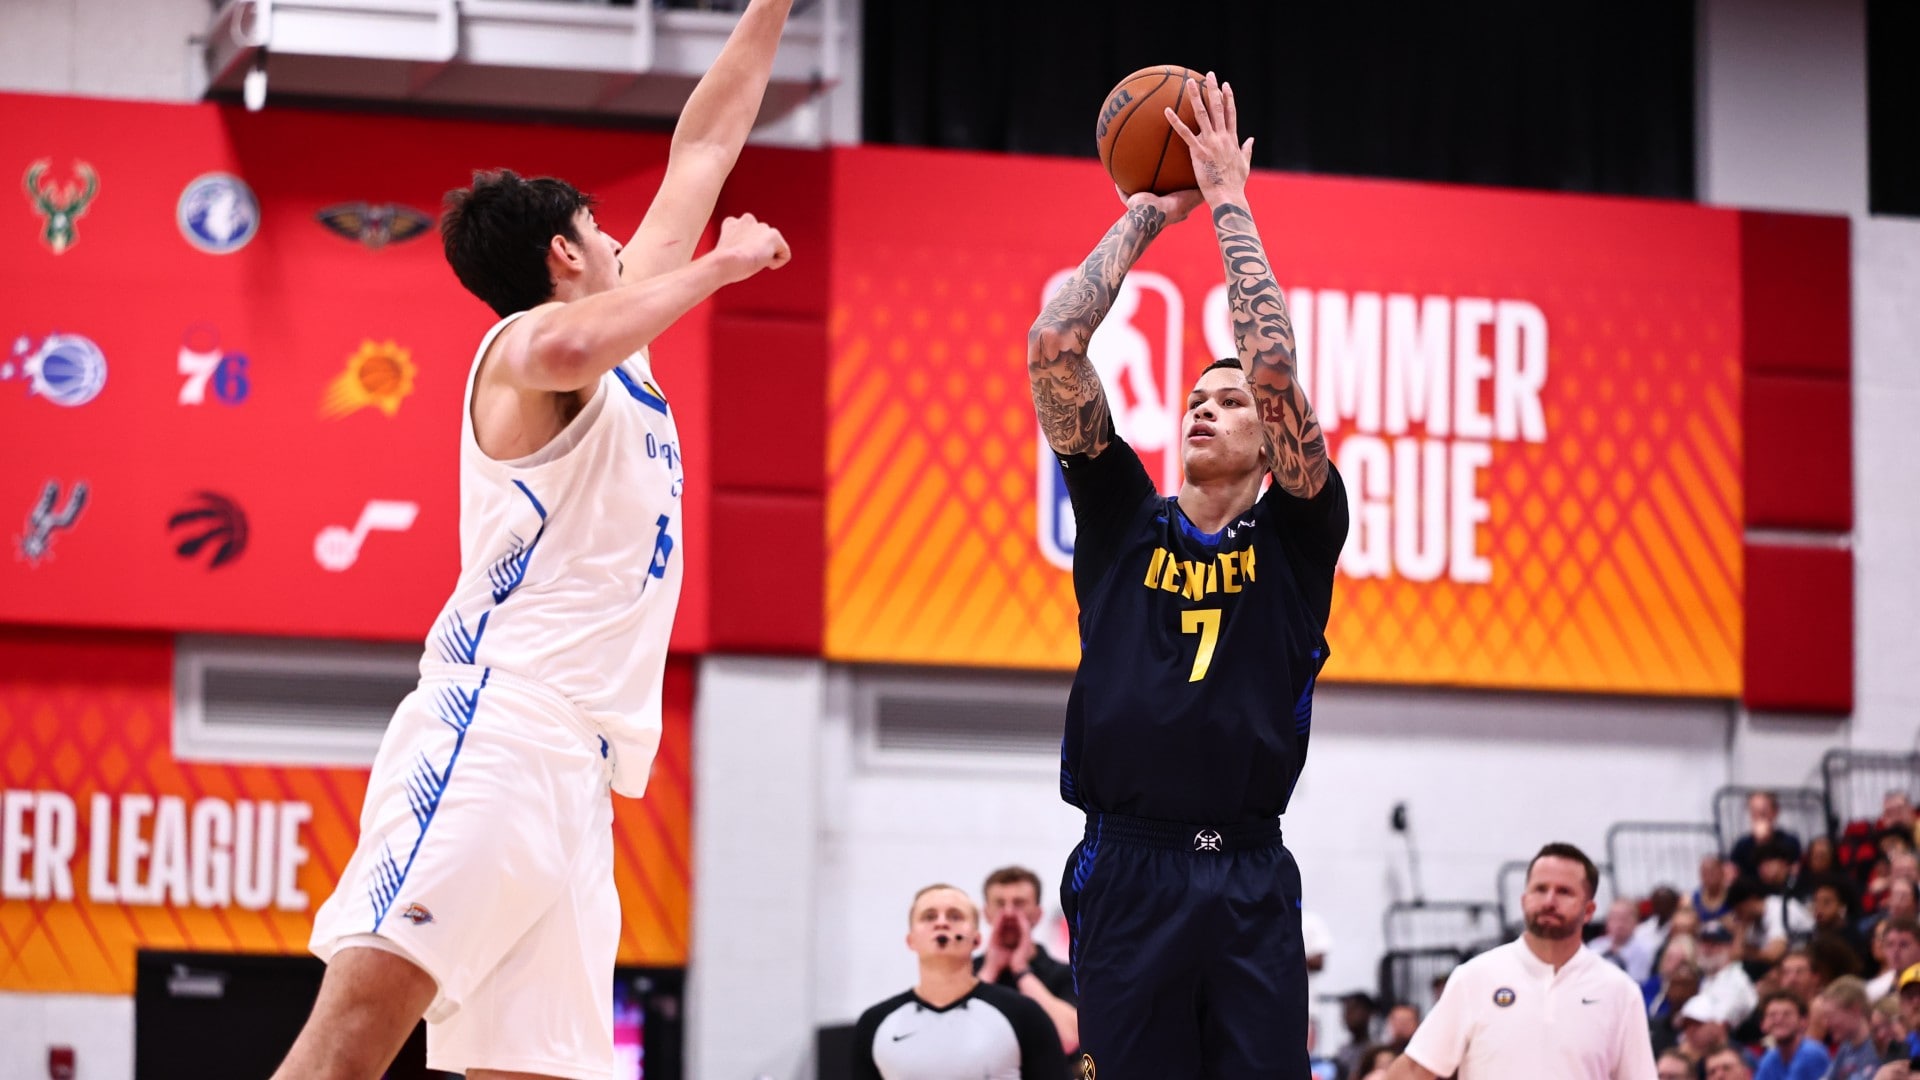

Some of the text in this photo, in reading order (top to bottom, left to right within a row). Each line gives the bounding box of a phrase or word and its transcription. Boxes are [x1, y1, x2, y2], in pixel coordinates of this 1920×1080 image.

[1096, 89, 1133, 141] Wil
[1213, 202, 1289, 340] Chosen
[178, 345, 250, 405] 76
[1181, 608, 1222, 683] 7
[0, 789, 312, 910] ER LEAGUE
